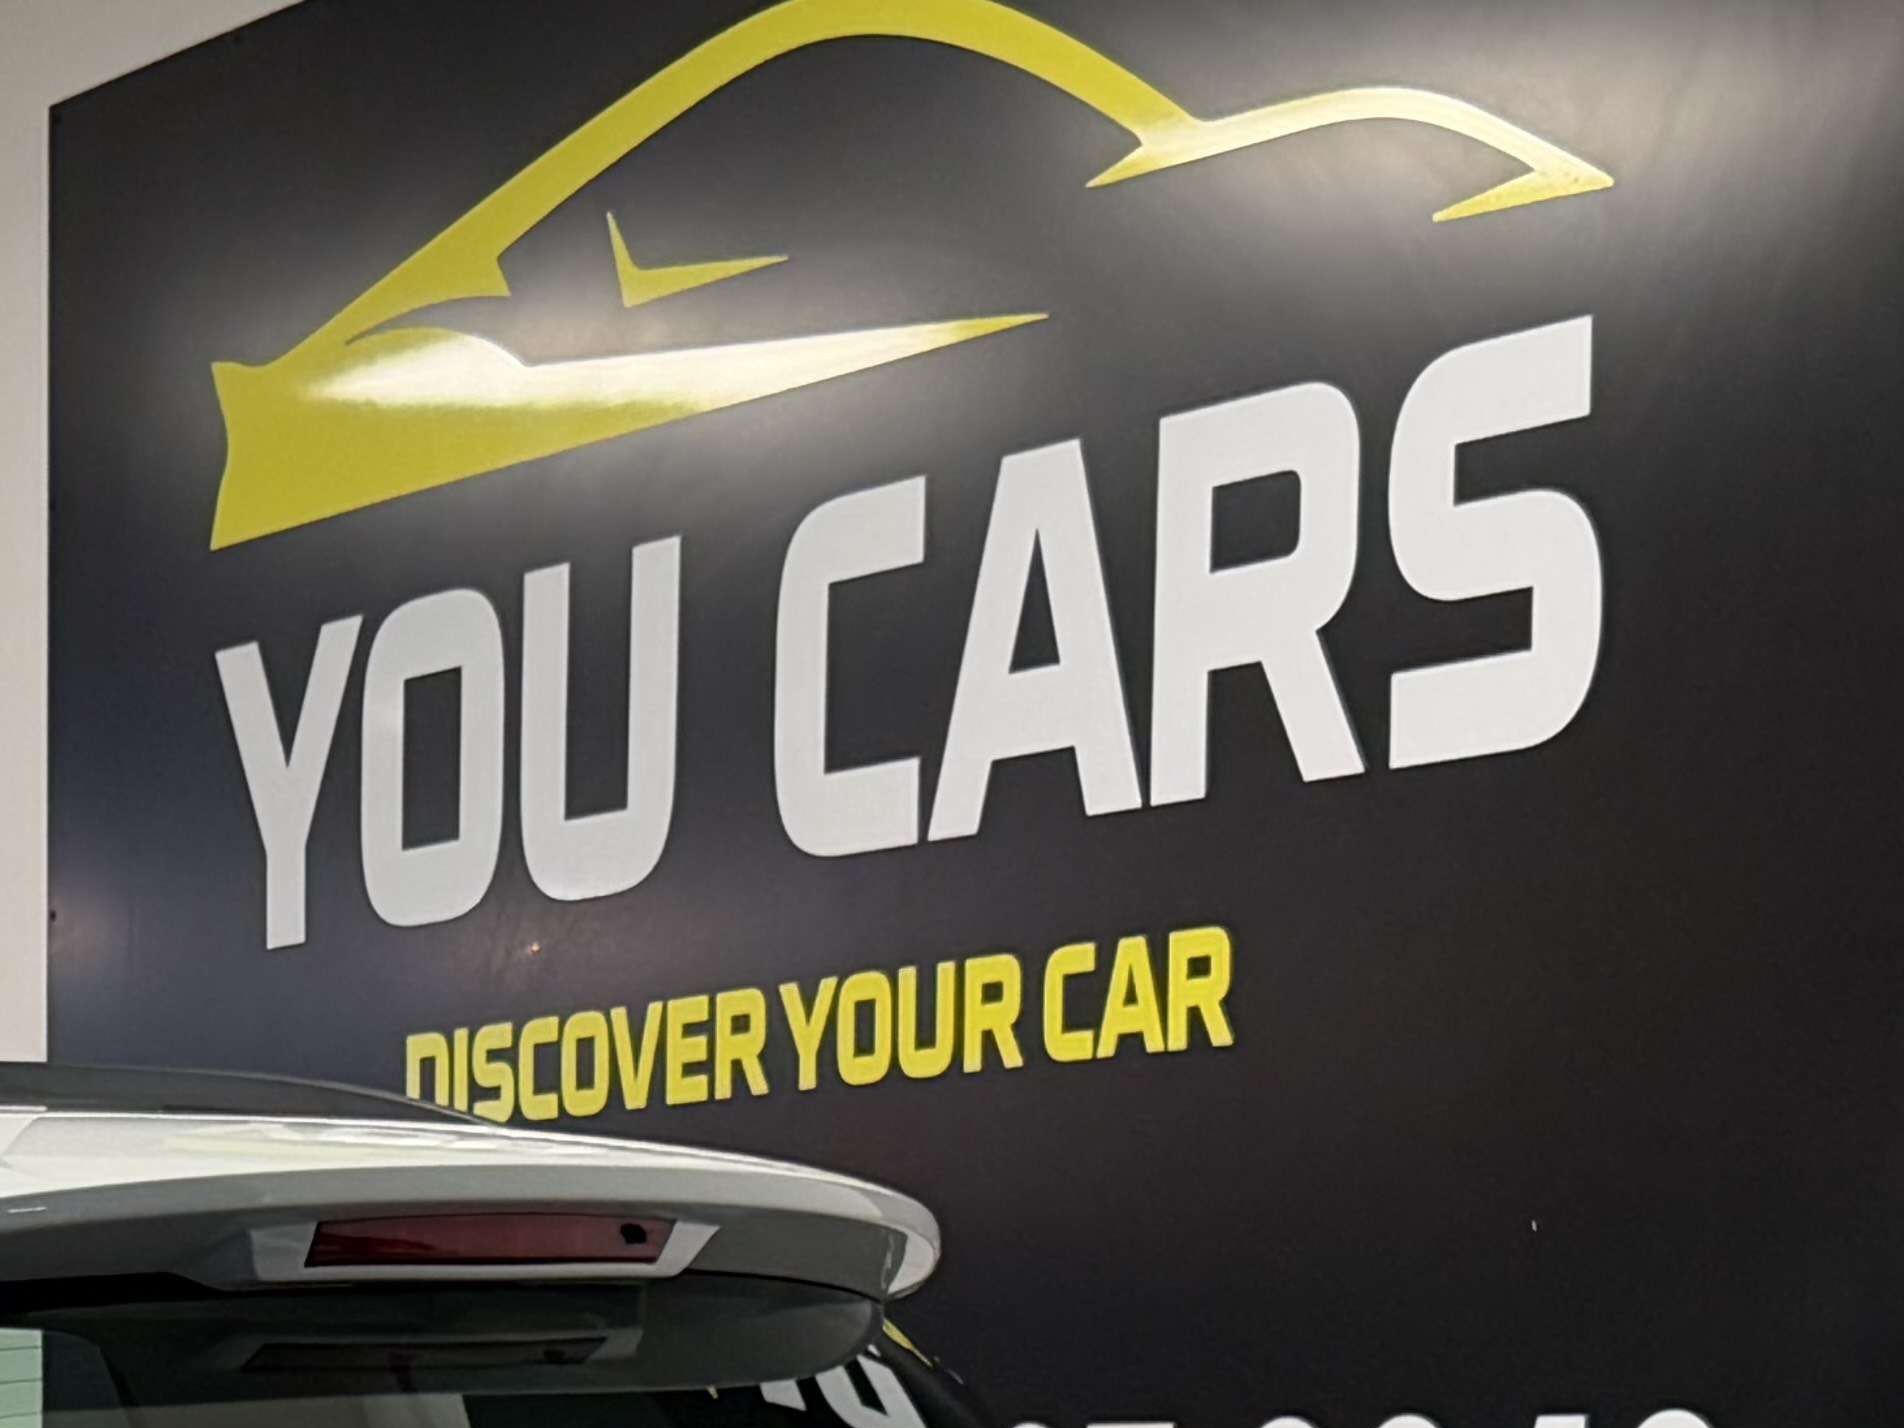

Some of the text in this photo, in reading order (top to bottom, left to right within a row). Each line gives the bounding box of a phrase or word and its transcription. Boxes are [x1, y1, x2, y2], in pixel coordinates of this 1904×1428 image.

[214, 313, 1604, 950] YOU CARS
[405, 926, 1233, 1123] DISCOVER YOUR CAR
